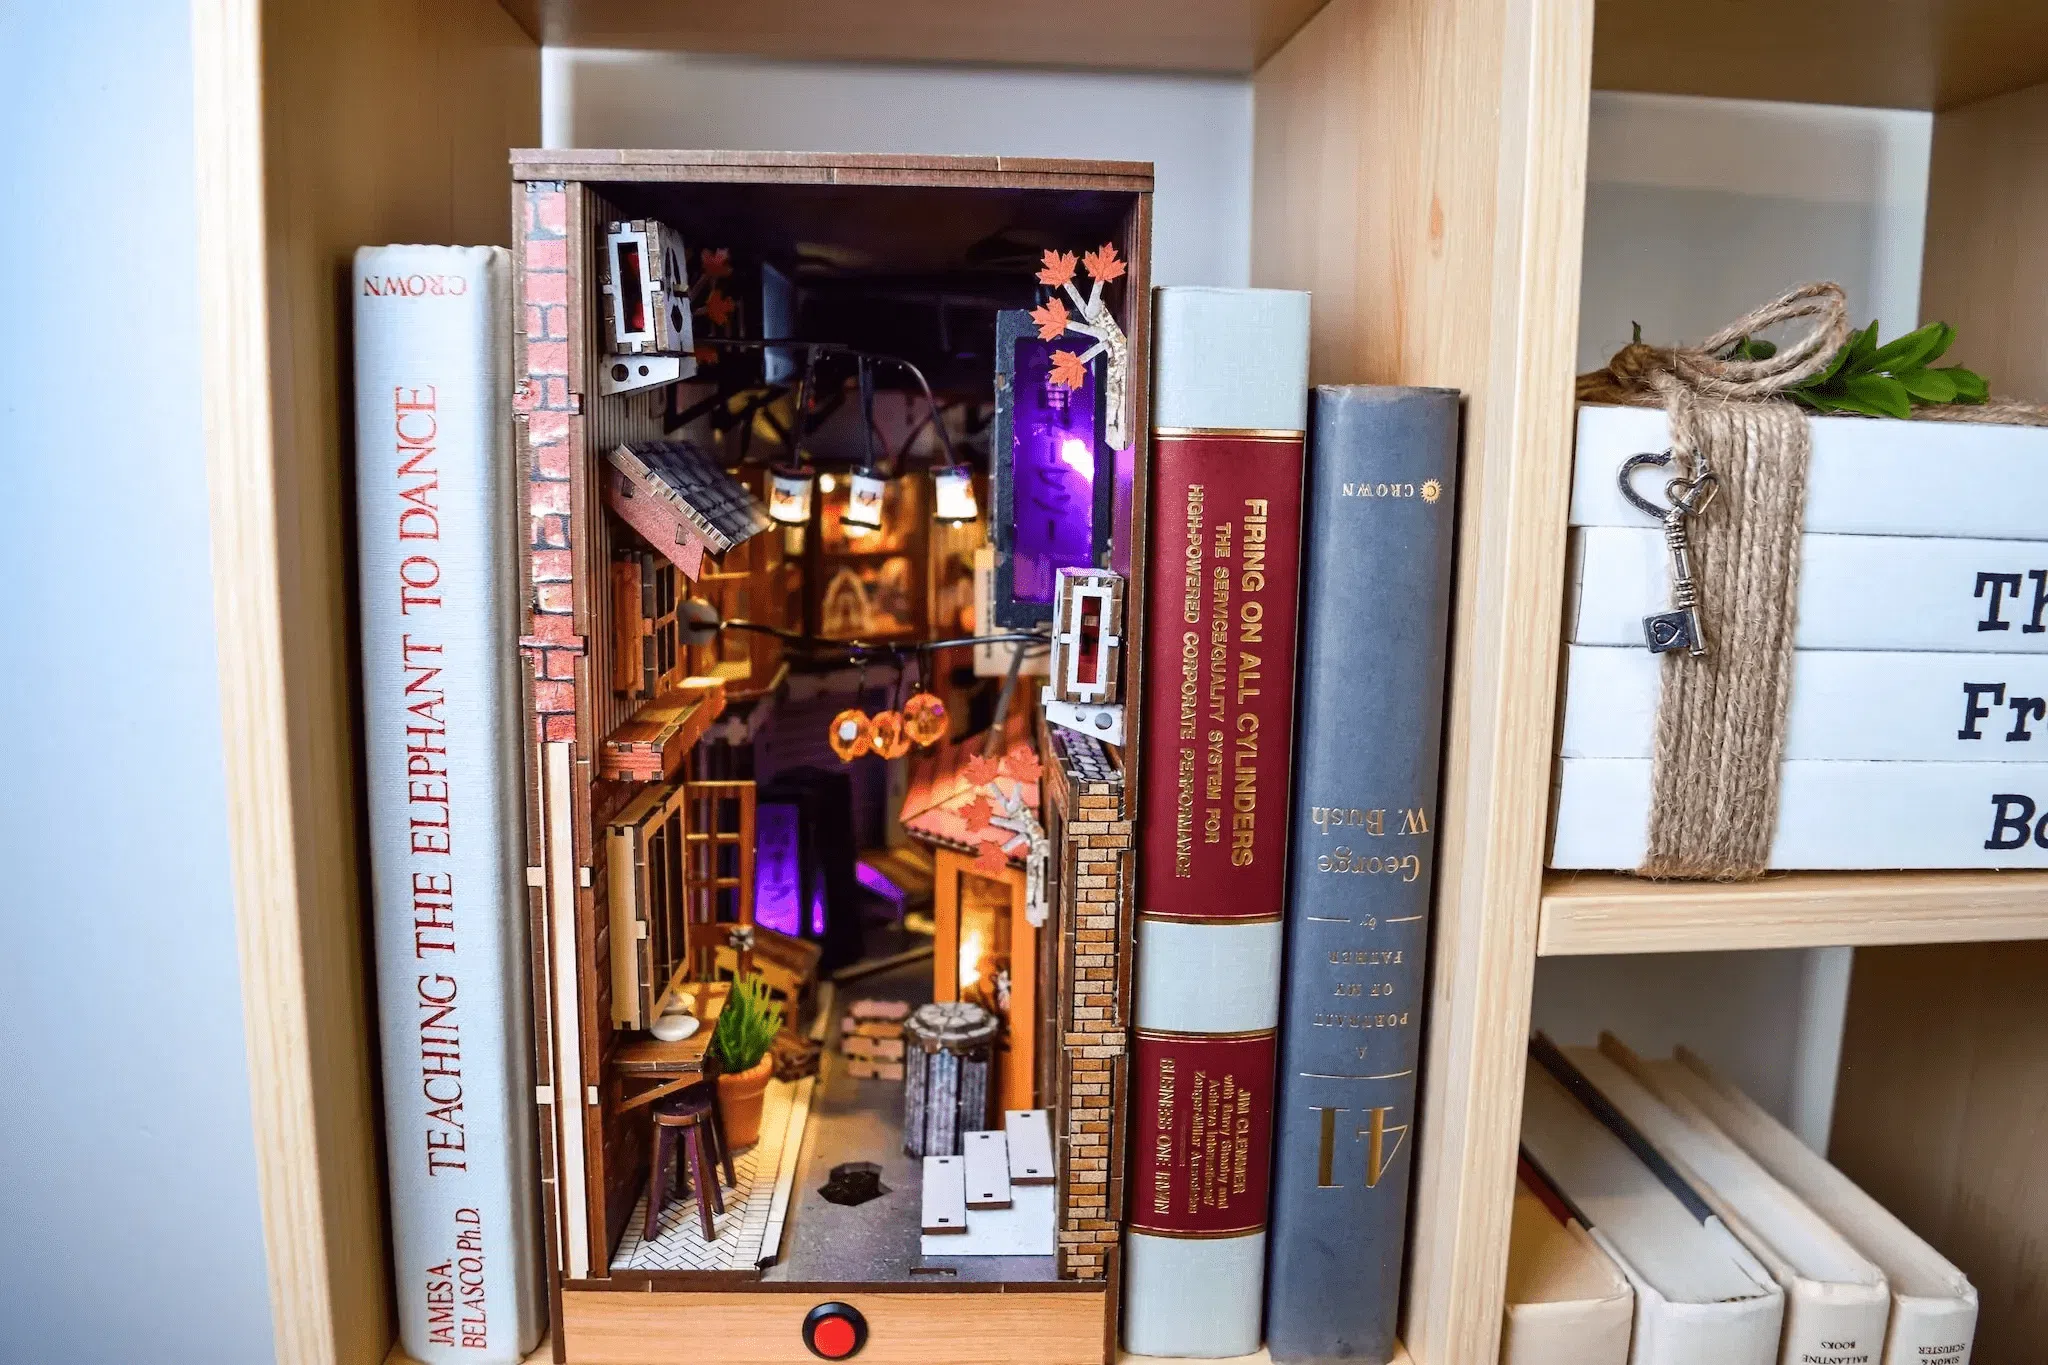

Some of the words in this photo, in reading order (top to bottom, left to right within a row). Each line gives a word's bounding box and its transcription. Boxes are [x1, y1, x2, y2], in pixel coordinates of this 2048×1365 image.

[363, 275, 467, 296] CROWN
[395, 385, 439, 541] DANCE
[1342, 483, 1414, 497] CROWN
[1183, 484, 1204, 623] HIGH-POWERED
[1215, 523, 1231, 558] THE
[1241, 498, 1268, 592] FIRING
[400, 556, 441, 615] TO
[1240, 601, 1263, 643] ON
[1209, 566, 1229, 722] SERVICE/QUALITY
[1180, 632, 1199, 740] CORPORATE
[1237, 651, 1261, 704] ALL
[402, 634, 451, 855] ELEPHANT
[1206, 730, 1224, 799] SYSTEM
[1231, 713, 1259, 867] CYLINDERS
[1176, 748, 1195, 879] PERFORMANCE
[1205, 808, 1221, 843] FOR
[1312, 806, 1386, 836] Bush
[1397, 807, 1428, 835] W.
[1317, 846, 1420, 882] George
[412, 872, 456, 959] THE
[1327, 950, 1402, 964] FATHER
[1334, 982, 1360, 996] MY
[1370, 982, 1393, 996] OF
[1312, 1012, 1408, 1027] PORTRAIT
[1355, 1046, 1368, 1060] A
[418, 973, 467, 1177] TEACHING
[1158, 1058, 1175, 1130] BUSINESS
[1223, 1074, 1234, 1099] with
[1220, 1104, 1233, 1135] Barry
[1237, 1088, 1251, 1114] JIM
[1156, 1135, 1172, 1166] ONE
[1233, 1118, 1249, 1194] CLEMMER
[1308, 1106, 1408, 1189] 41
[1154, 1171, 1171, 1214] IRWIN
[1218, 1187, 1229, 1209] and
[455, 1208, 482, 1252] Ph.D.
[426, 1259, 452, 1278] A.
[427, 1281, 454, 1347] JAMES
[458, 1256, 486, 1349] BELASCO,
[1803, 1355, 1869, 1365] BALLANTINE
[1821, 1341, 1856, 1350] BOOKS
[1918, 1343, 1966, 1355] SCHUSTER
